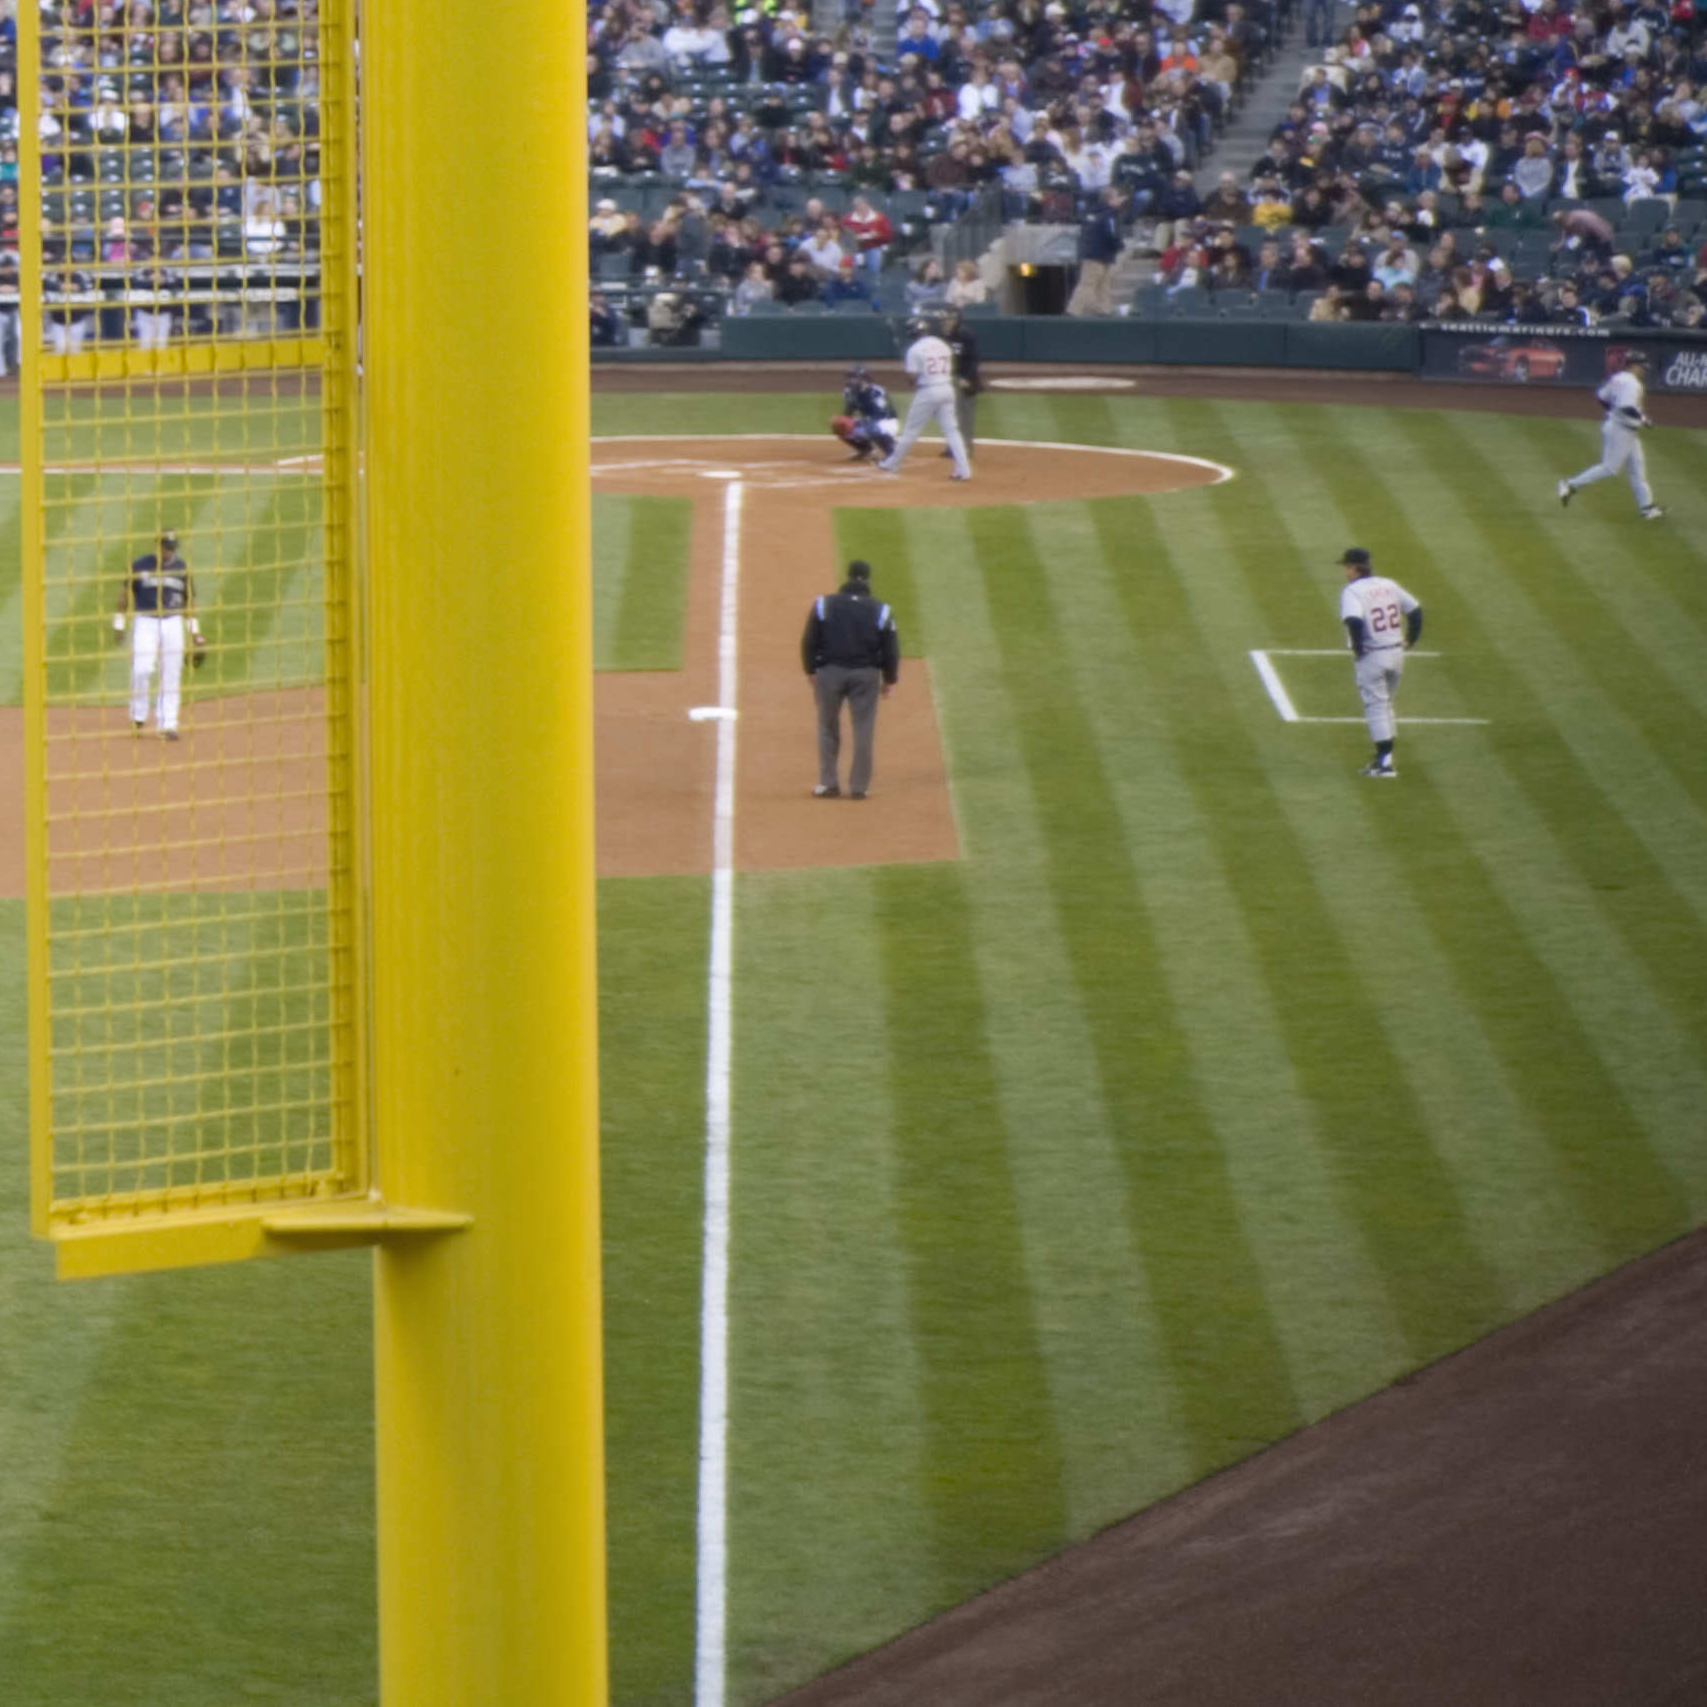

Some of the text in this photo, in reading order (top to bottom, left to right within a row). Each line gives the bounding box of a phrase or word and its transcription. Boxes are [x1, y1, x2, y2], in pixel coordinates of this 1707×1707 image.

[1441, 321, 1611, 338] seattlemariners.com
[926, 356, 949, 376] 27
[1370, 603, 1401, 634] 22
